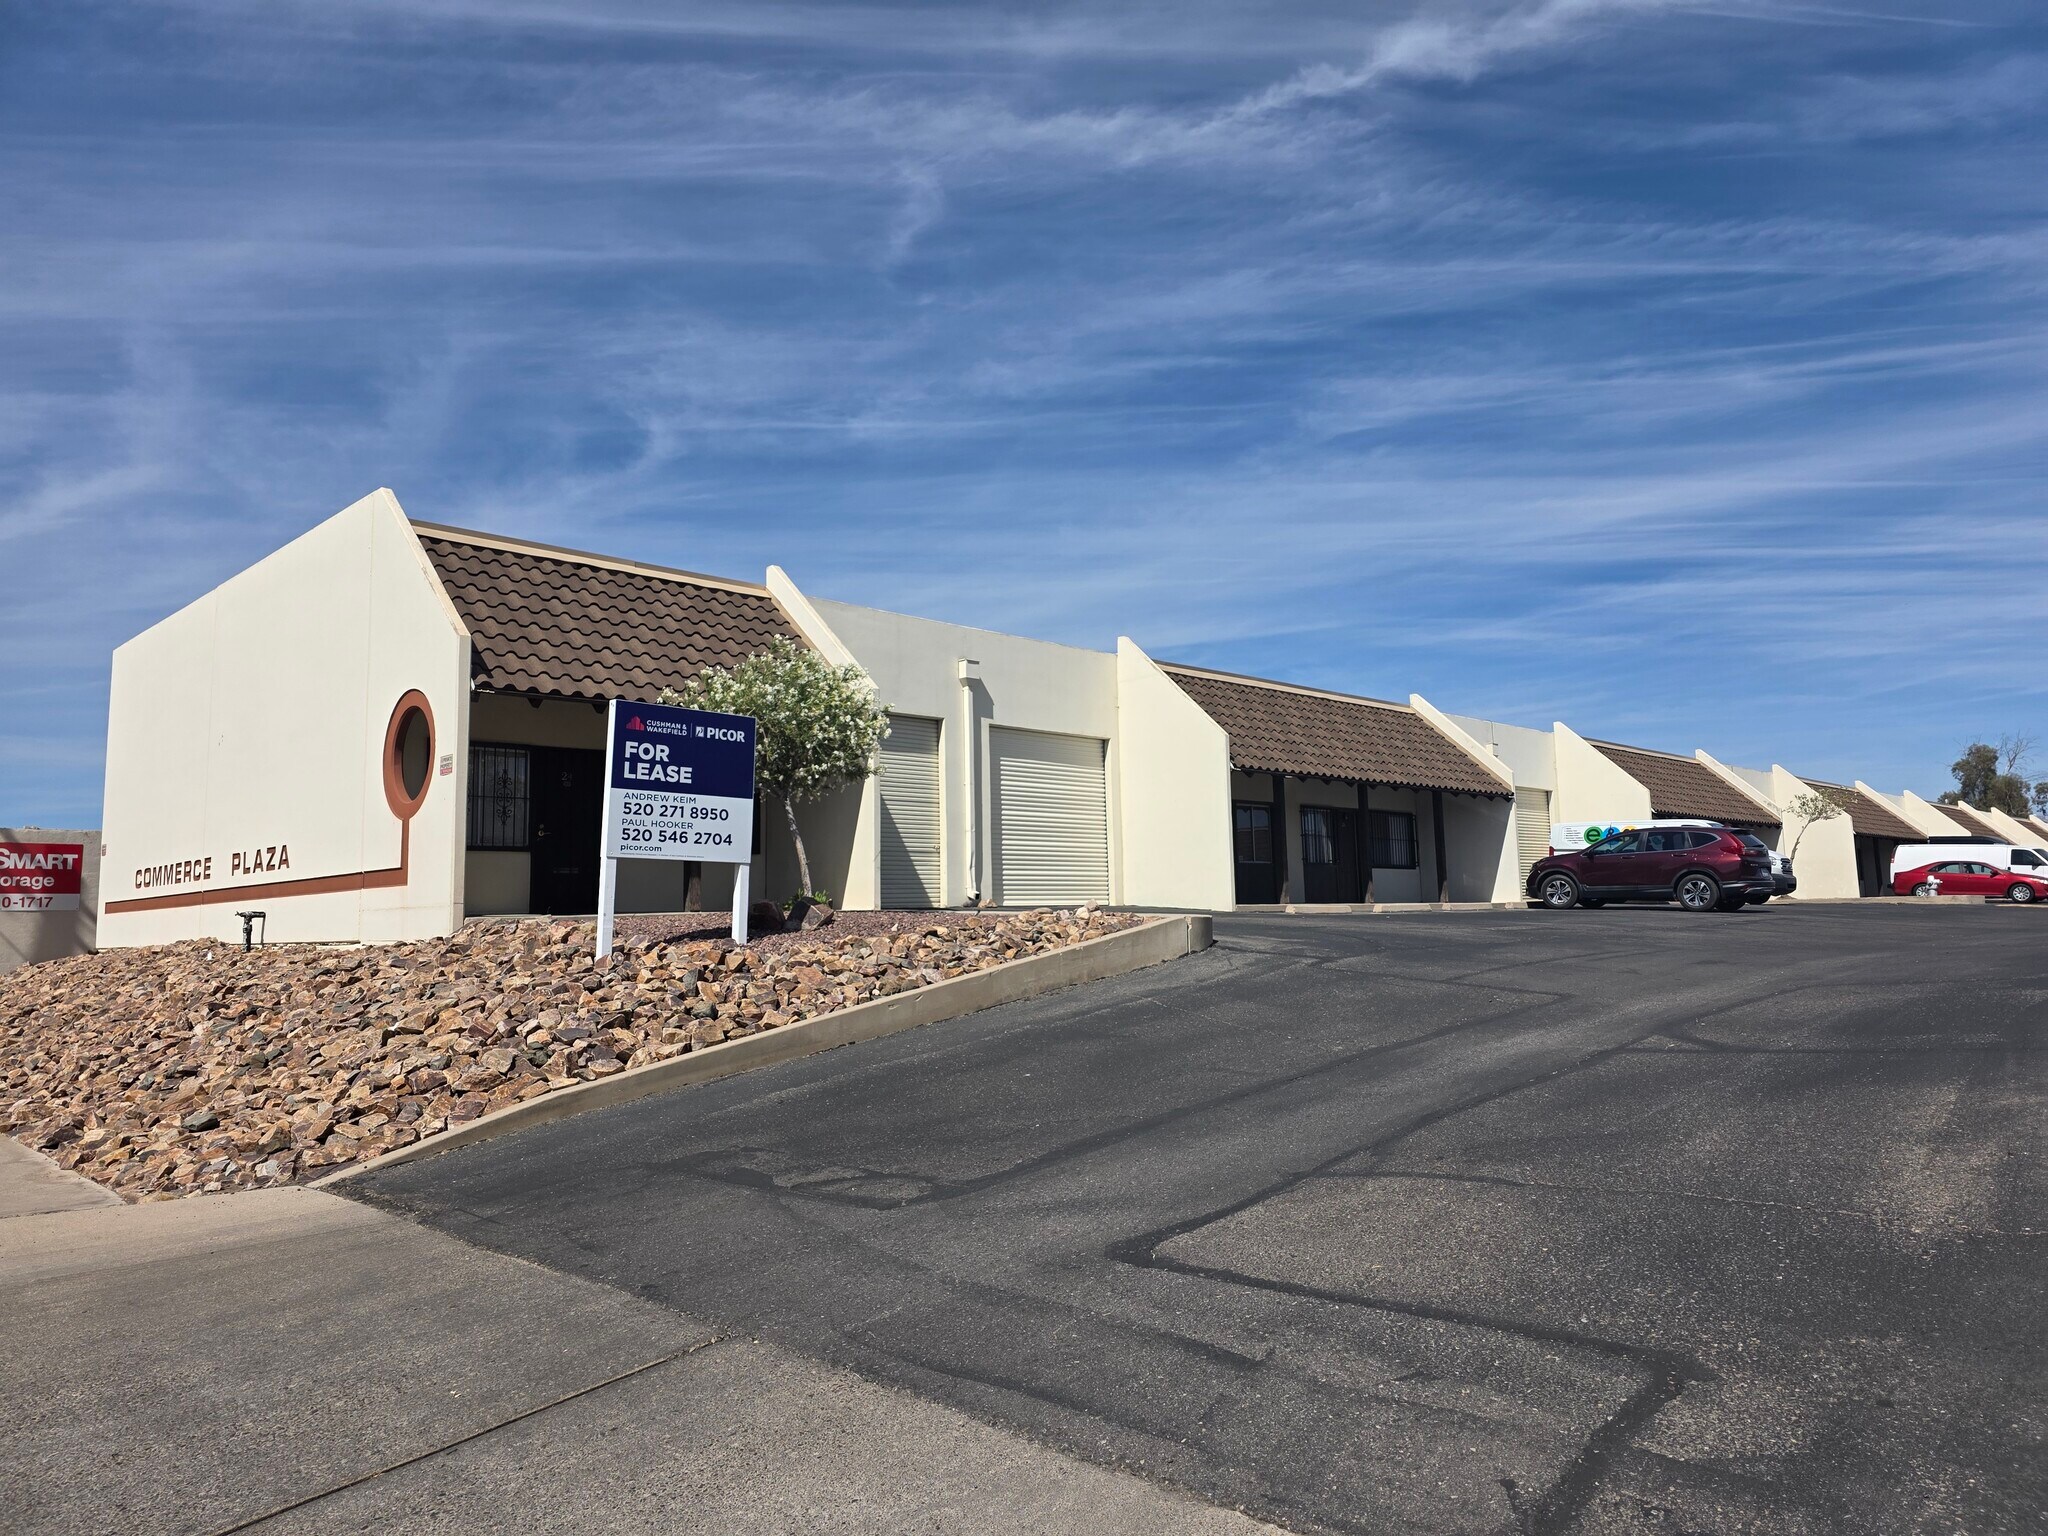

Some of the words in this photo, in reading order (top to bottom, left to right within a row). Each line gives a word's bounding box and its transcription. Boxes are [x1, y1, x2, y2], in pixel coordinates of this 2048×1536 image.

[647, 720, 681, 729] CUSHMAN
[647, 726, 688, 736] WAKEFIELD
[706, 727, 745, 743] PICOR
[625, 741, 670, 762] FOR
[624, 761, 693, 784] LEASE
[623, 792, 671, 802] ANDREW
[673, 796, 697, 804] KEIM
[623, 802, 654, 816] 520
[659, 805, 684, 818] 271
[690, 807, 729, 821] 8950
[621, 818, 648, 827] PAUL
[651, 820, 694, 829] HOOKER
[621, 828, 652, 842] 520
[658, 830, 688, 844] 546
[693, 832, 733, 846] 2704
[620, 843, 662, 852] picor.com
[135, 857, 212, 889] COMMERCE
[231, 844, 290, 876] PLAZA
[0, 875, 55, 890] orage
